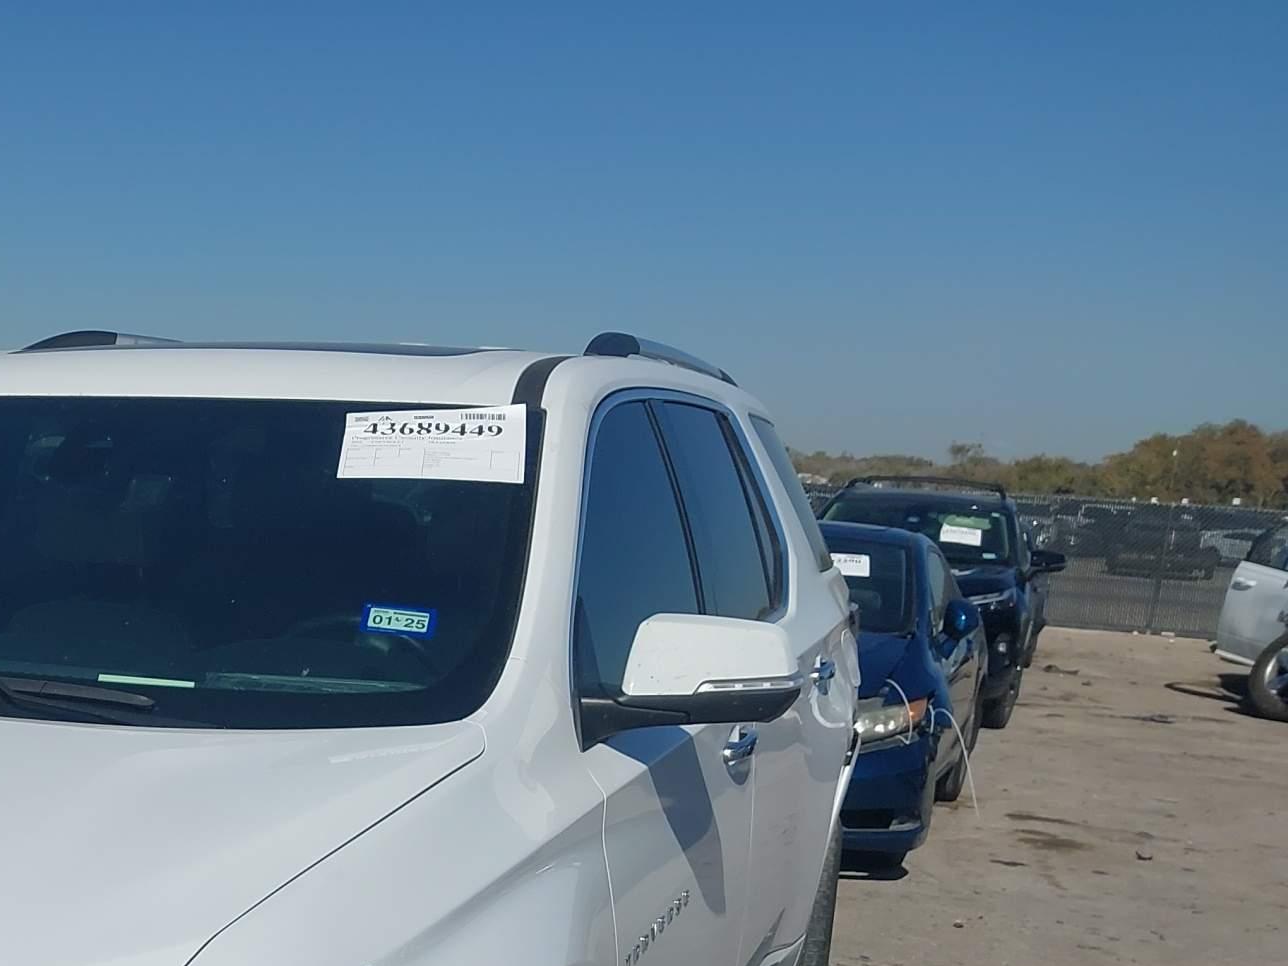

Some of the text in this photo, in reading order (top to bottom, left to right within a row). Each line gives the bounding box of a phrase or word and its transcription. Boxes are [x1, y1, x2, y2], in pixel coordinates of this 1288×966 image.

[363, 422, 504, 437] 43689449
[372, 614, 393, 626] 01
[403, 617, 427, 630] 25
